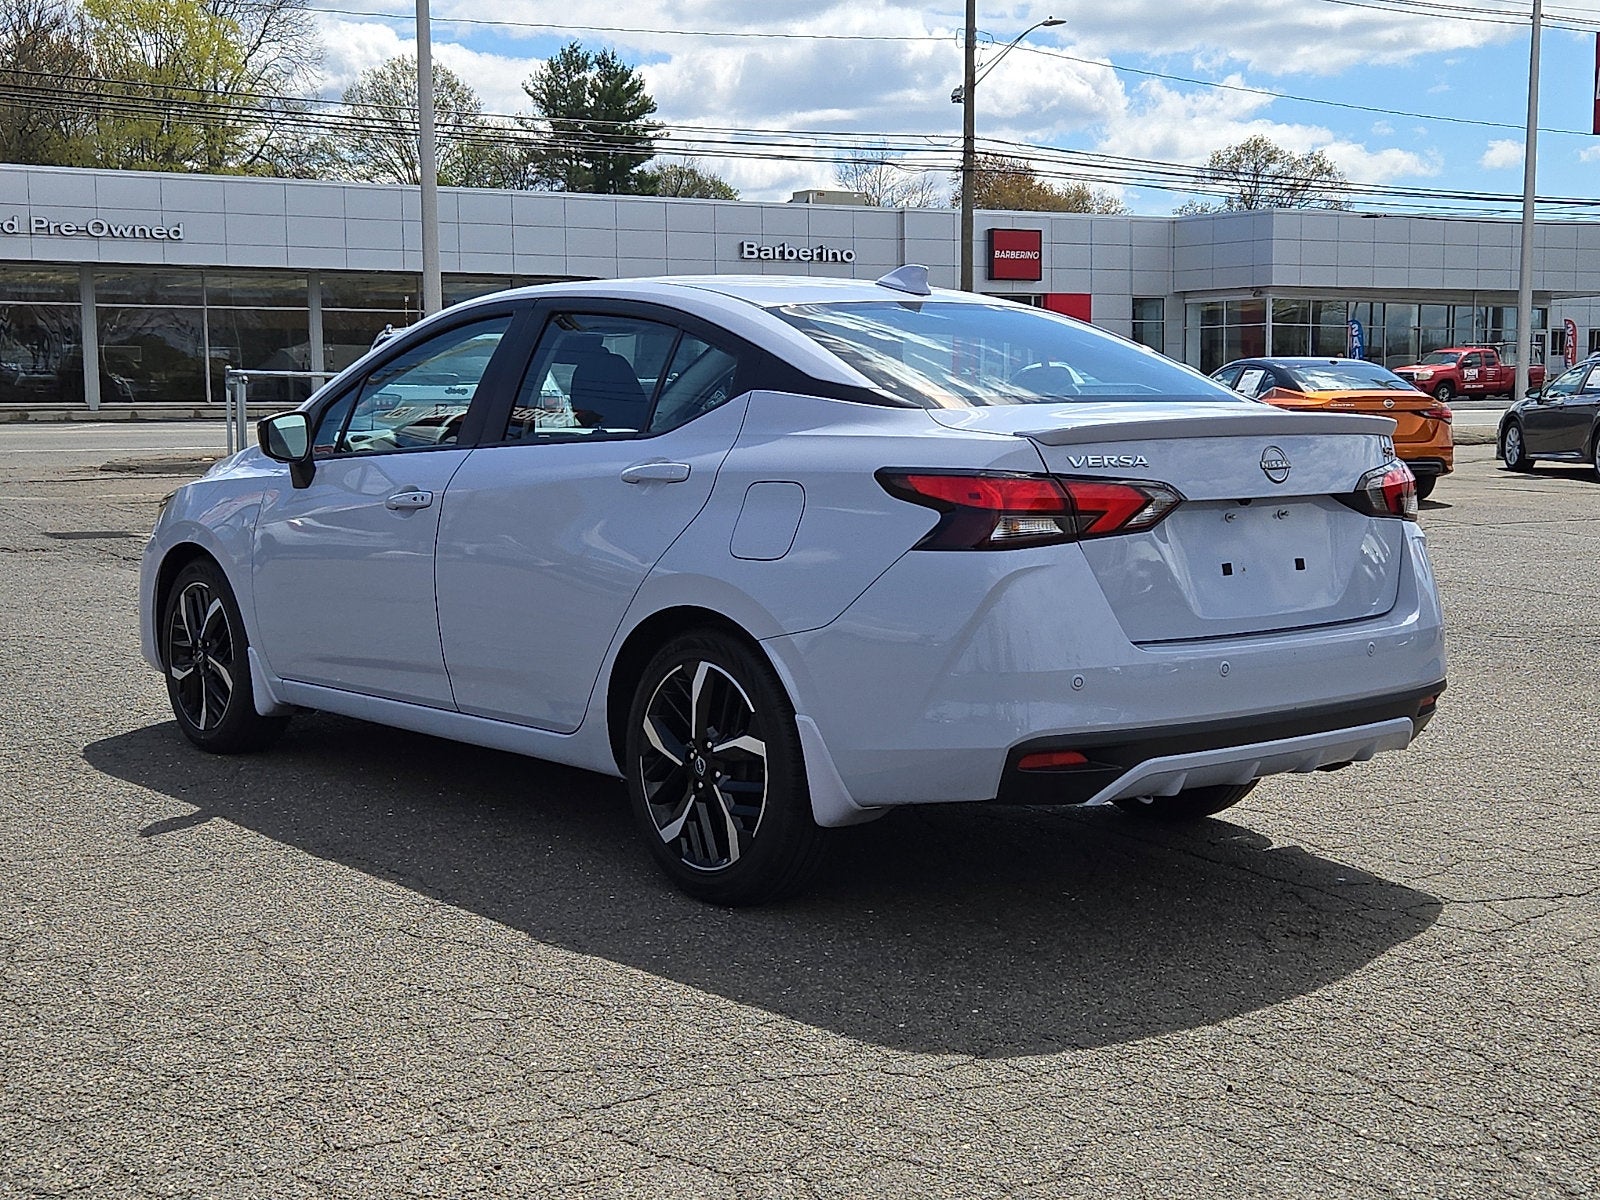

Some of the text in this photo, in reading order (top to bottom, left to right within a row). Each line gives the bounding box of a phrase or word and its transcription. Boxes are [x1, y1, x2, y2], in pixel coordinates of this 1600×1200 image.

[30, 216, 184, 240] Pre-Owned
[740, 240, 856, 263] Barberino
[994, 250, 1040, 260] BARBERINO
[1066, 455, 1149, 469] VERSA
